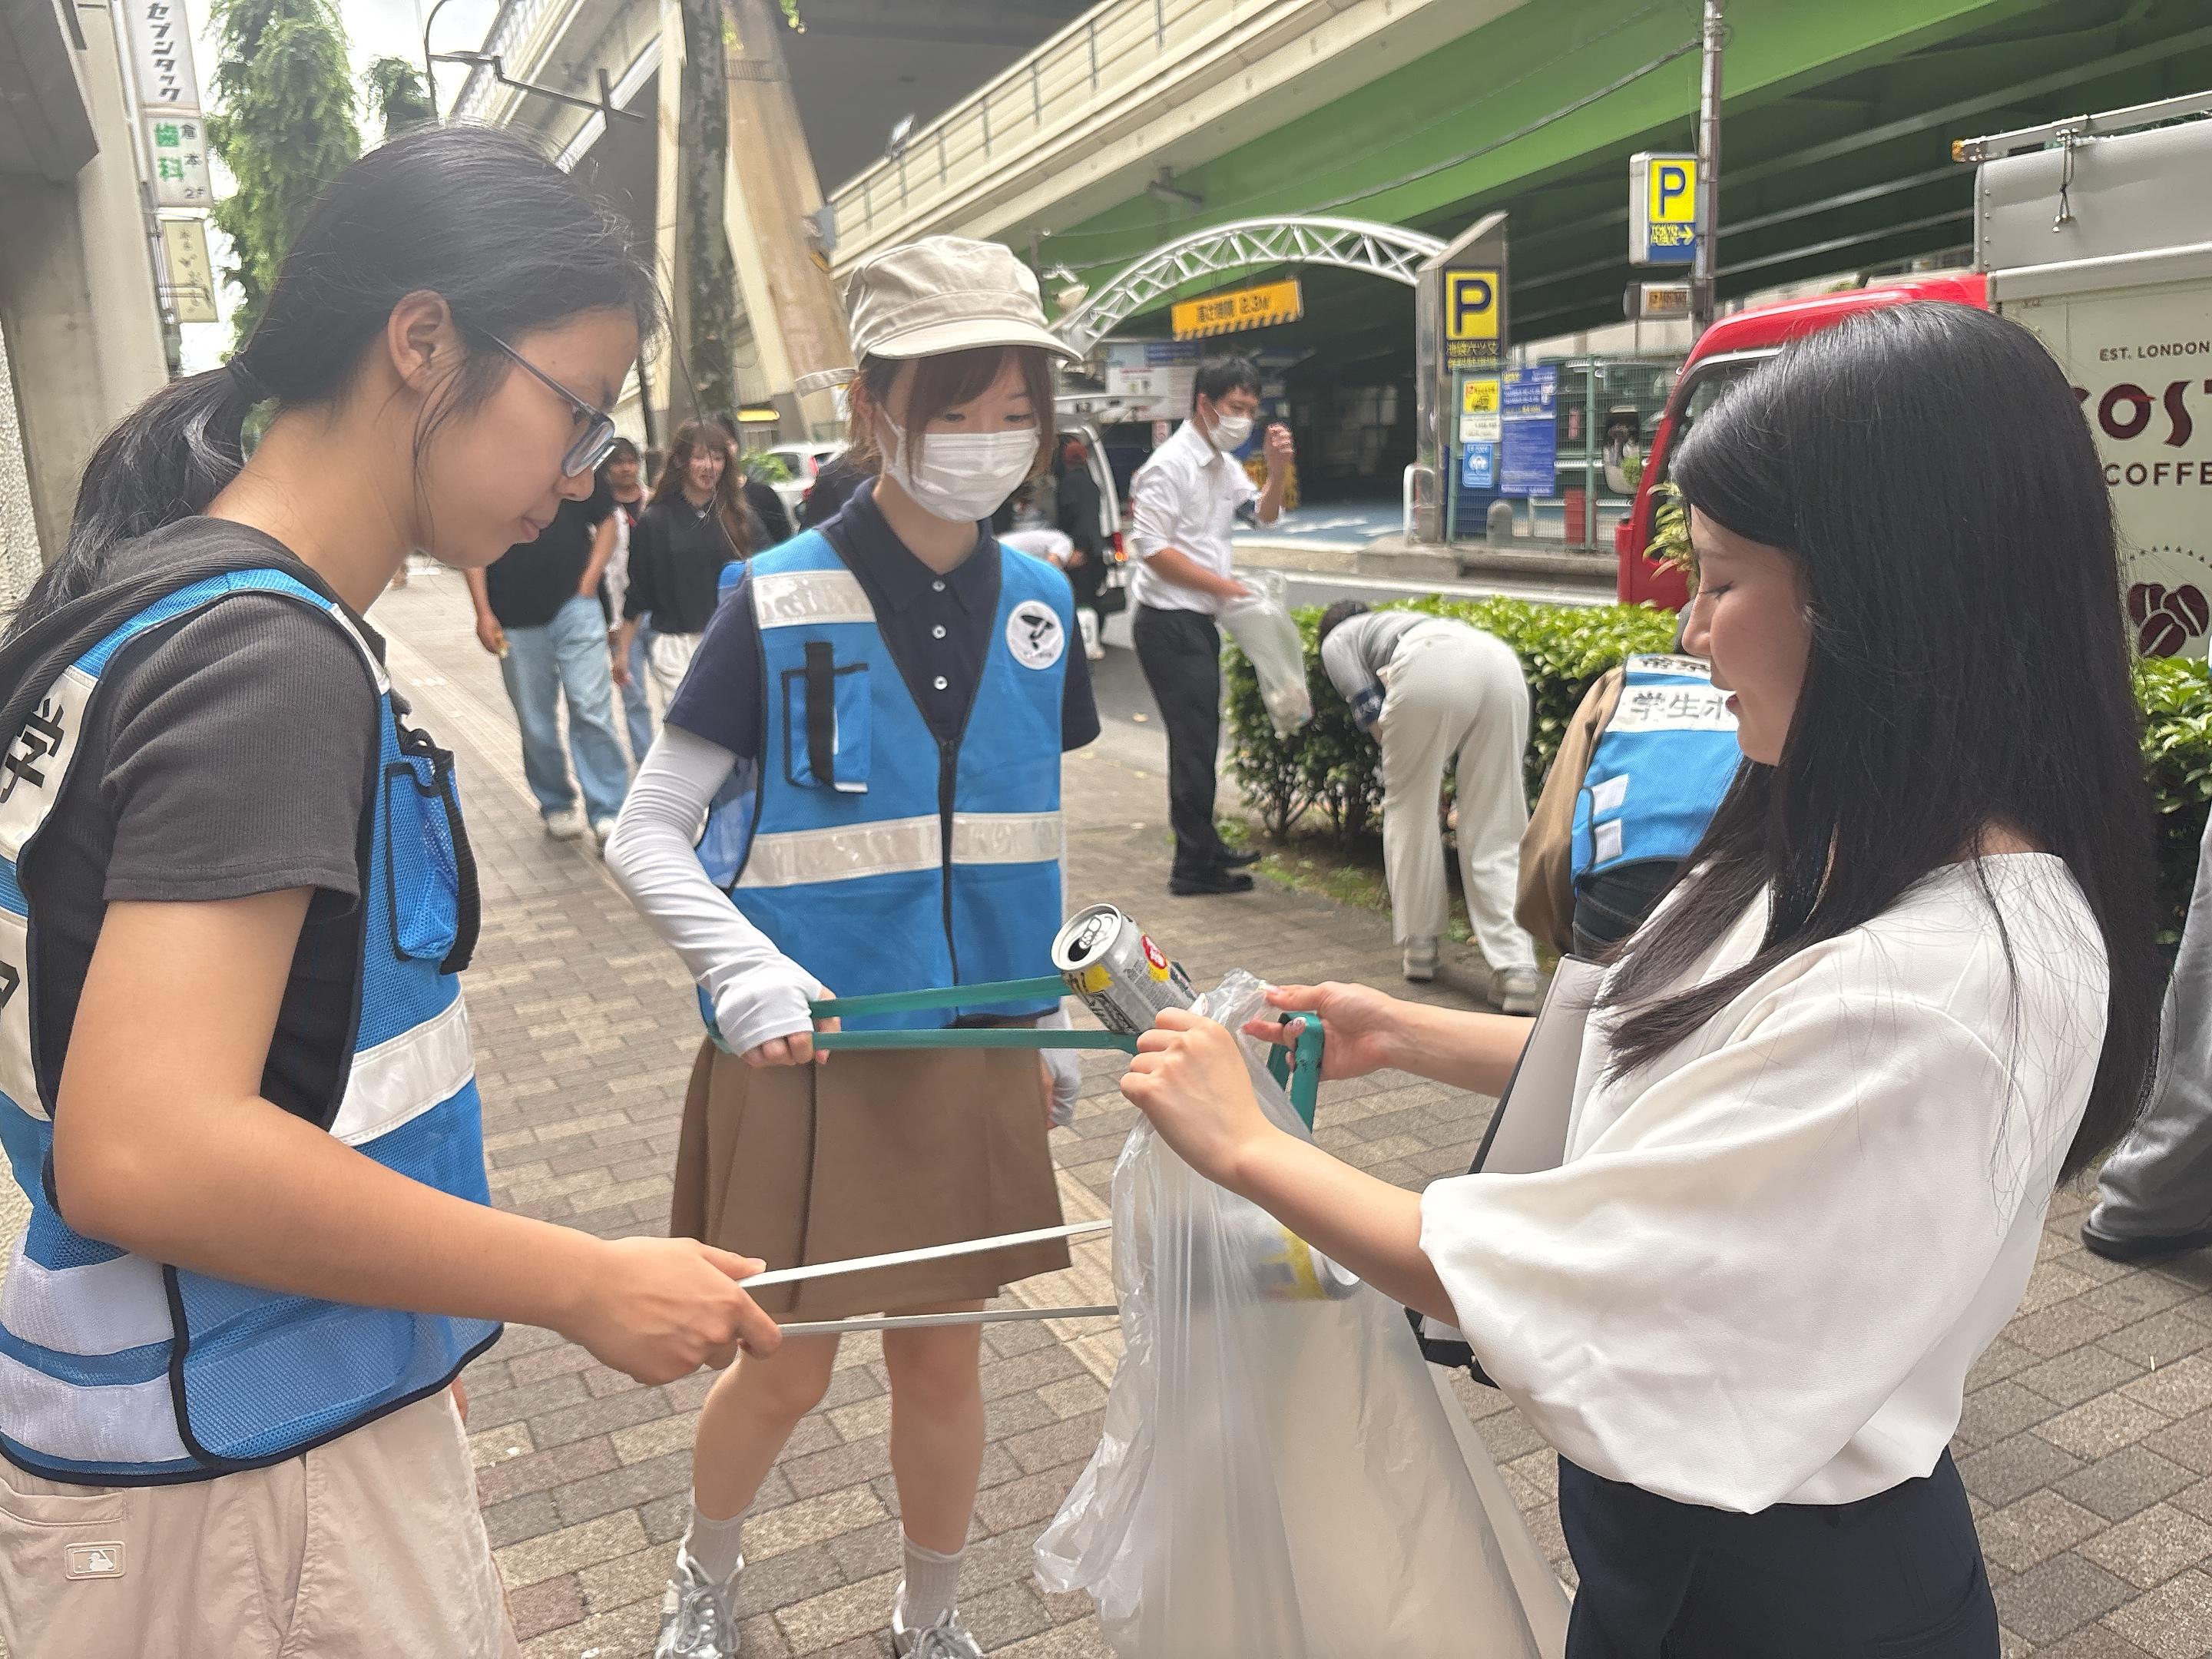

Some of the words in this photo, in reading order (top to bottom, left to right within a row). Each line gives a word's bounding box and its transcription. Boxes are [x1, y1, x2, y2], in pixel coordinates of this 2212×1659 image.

[1660, 167, 1686, 217] P
[1456, 280, 1492, 334] P
[2099, 347, 2132, 362] EST.
[2137, 339, 2210, 359] LONDON
[2071, 379, 2212, 449] OS
